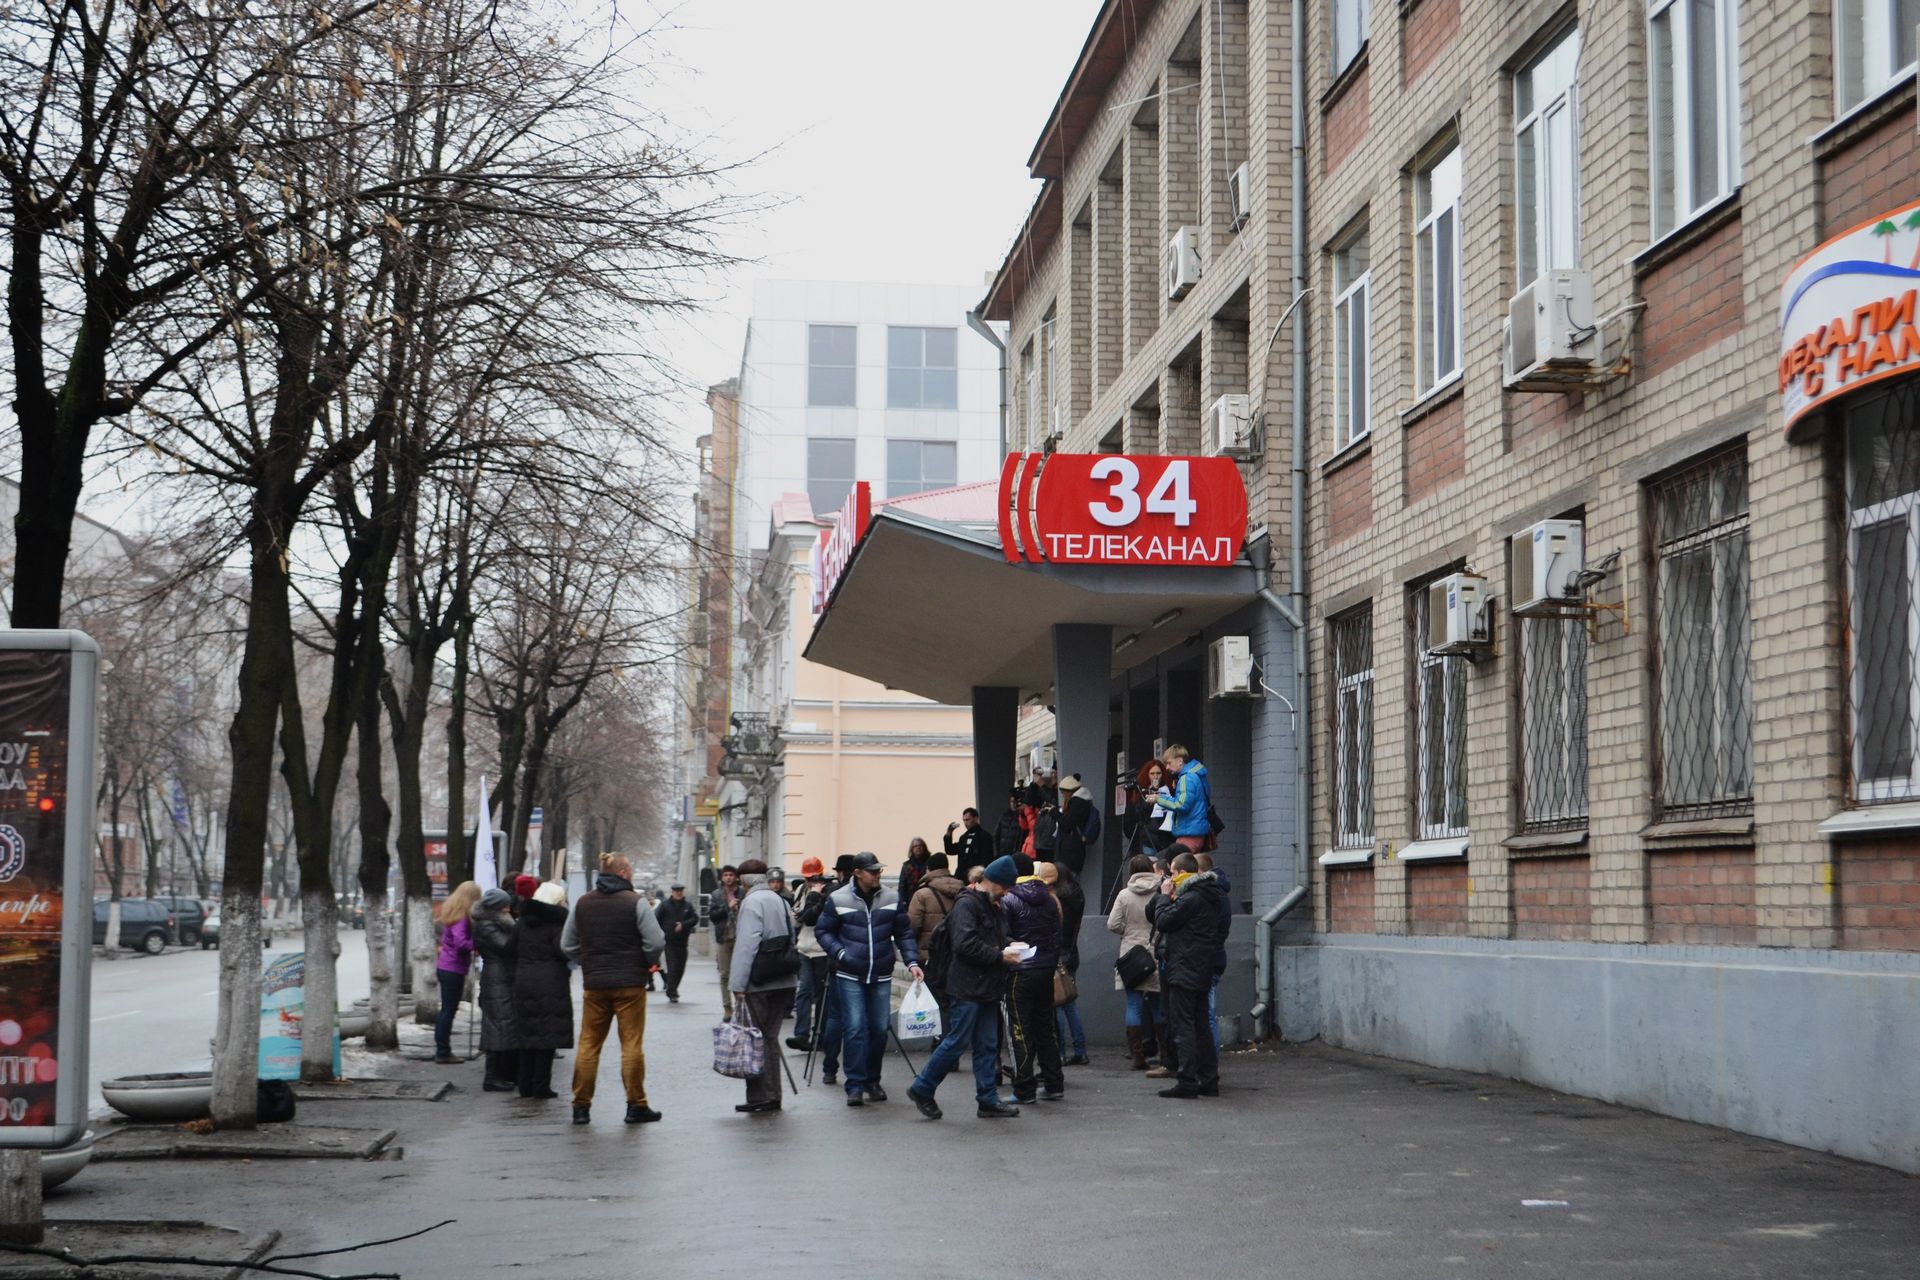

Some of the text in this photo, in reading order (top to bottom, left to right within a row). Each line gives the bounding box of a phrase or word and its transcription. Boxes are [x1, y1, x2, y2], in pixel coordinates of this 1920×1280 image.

[1803, 362, 1824, 397] С
[1088, 457, 1197, 527] 34
[1046, 533, 1231, 562] ТЕЛЕКАНАЛ
